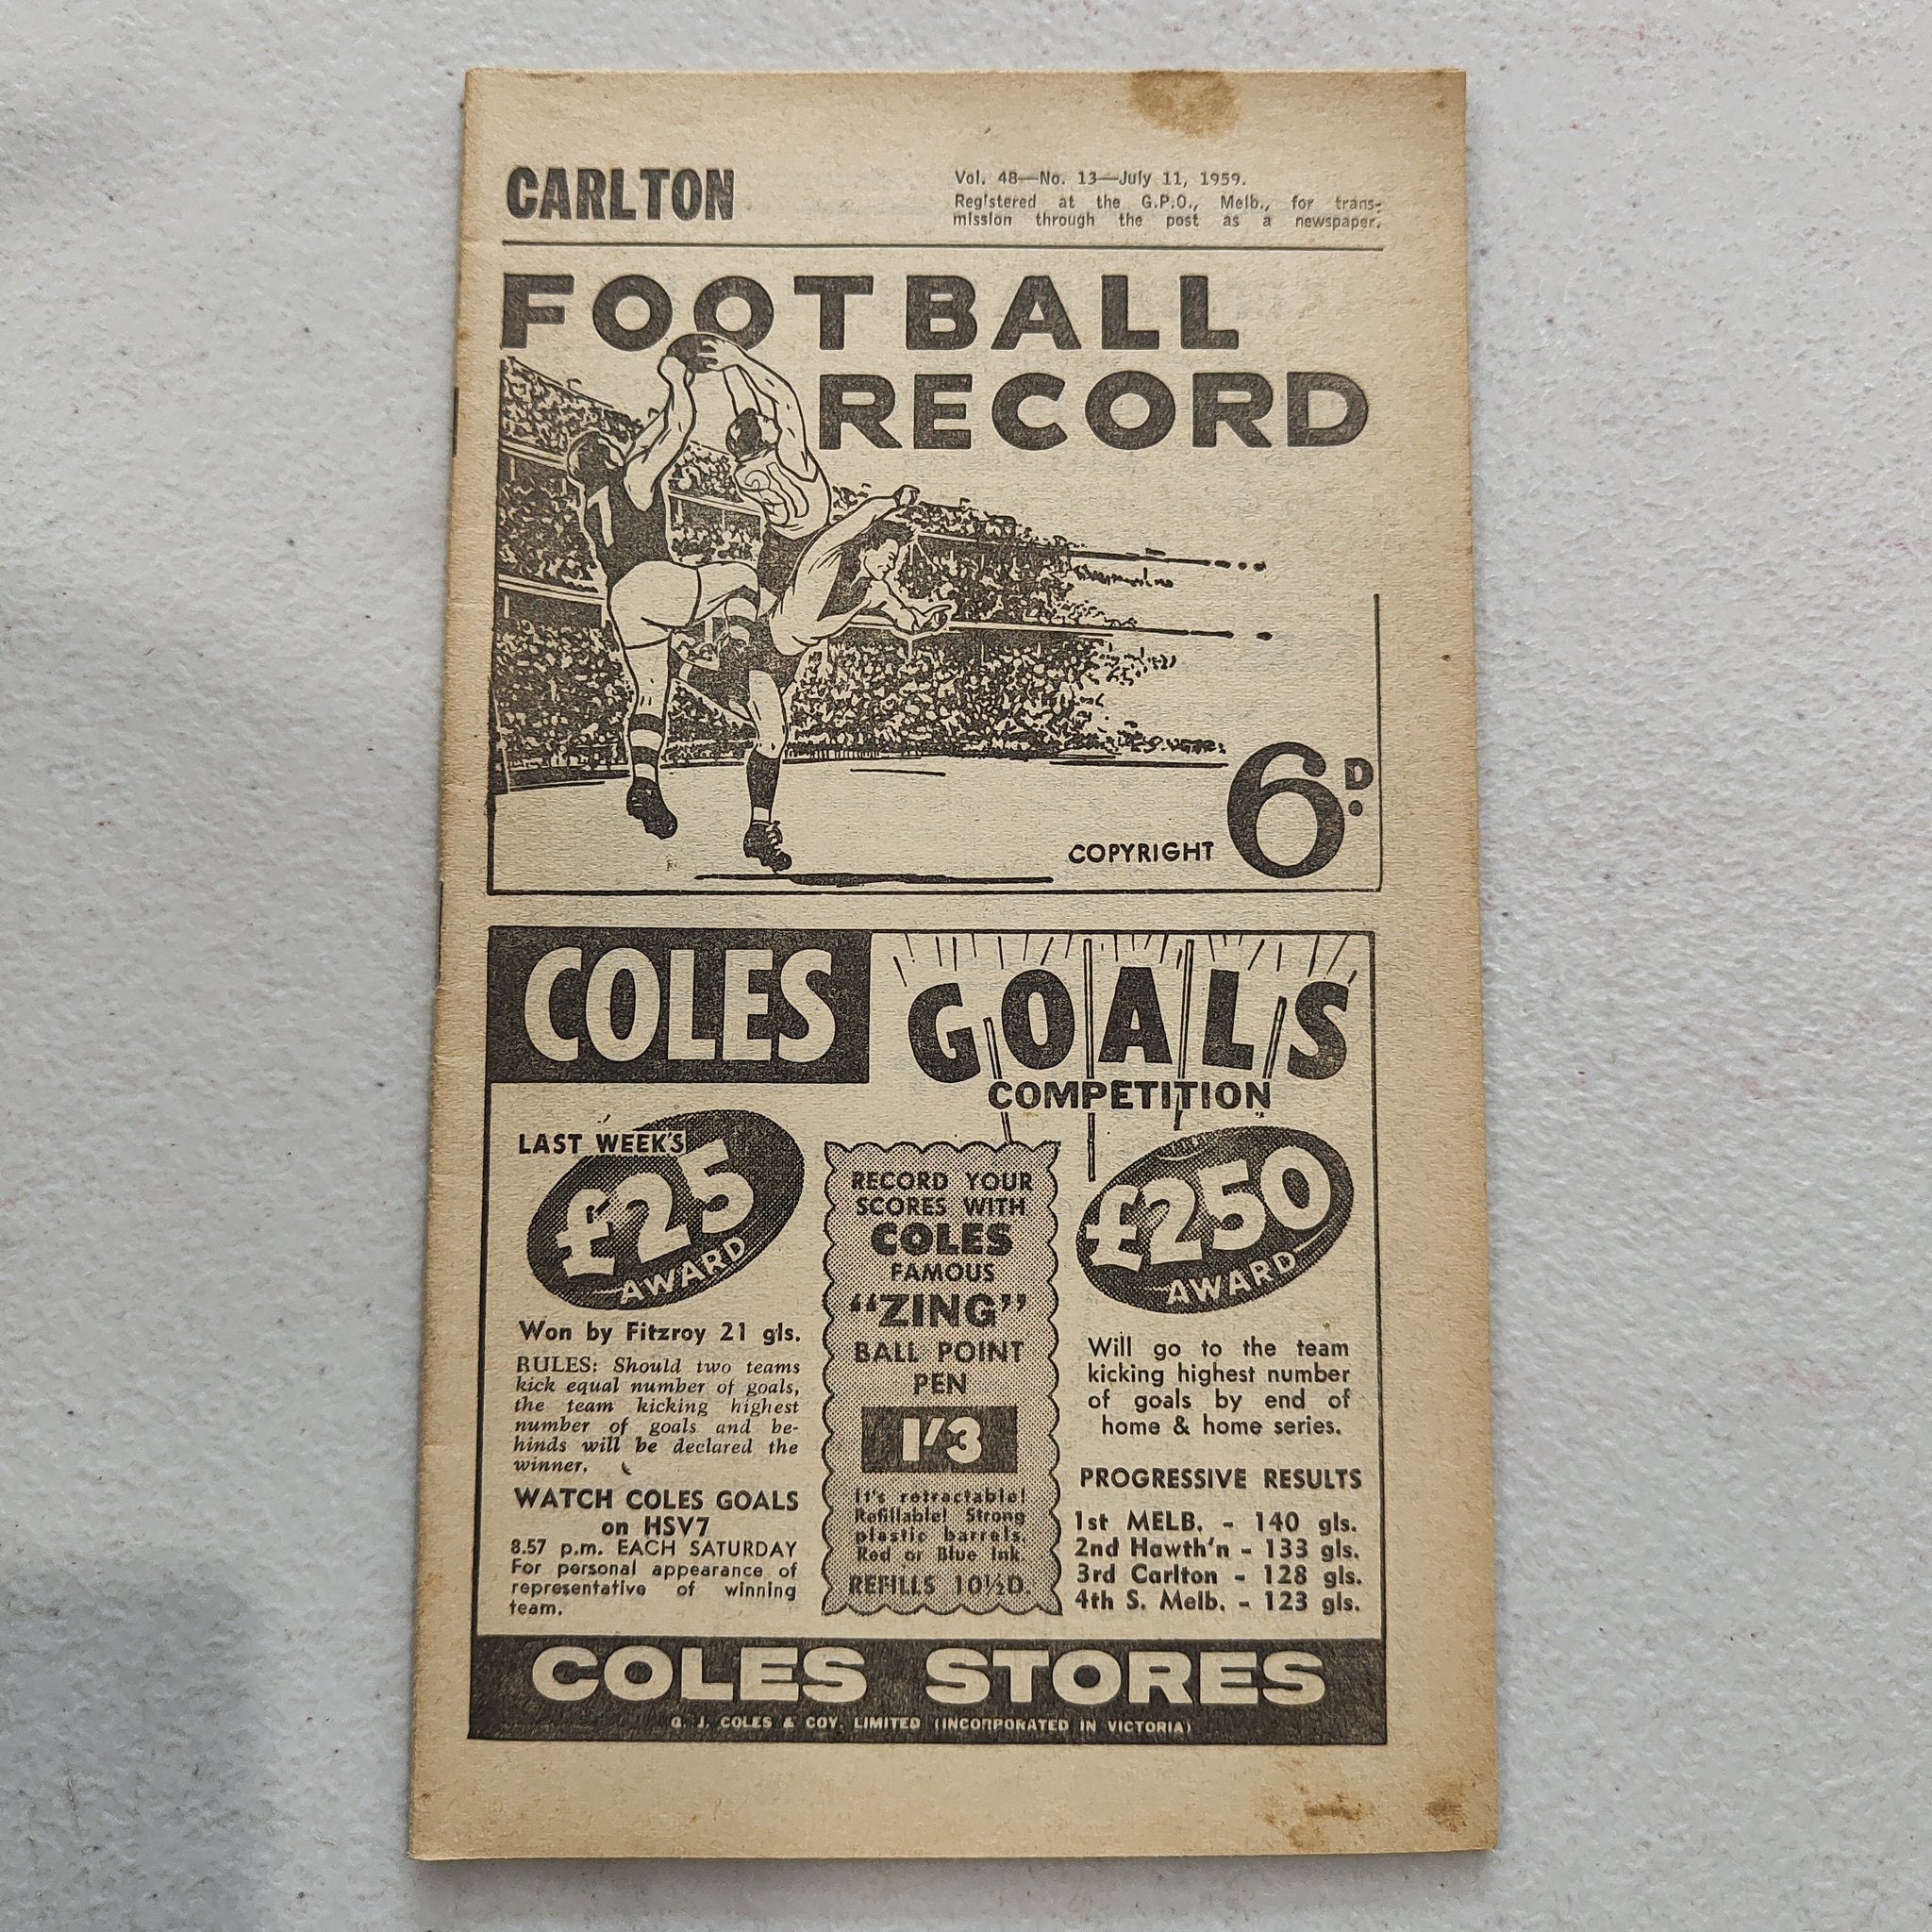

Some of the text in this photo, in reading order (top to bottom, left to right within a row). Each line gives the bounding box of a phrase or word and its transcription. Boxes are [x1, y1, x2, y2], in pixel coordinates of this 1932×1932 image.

[955, 170, 986, 185] Vol.
[1162, 171, 1188, 188] 11,
[1200, 172, 1246, 186] 1959.
[506, 167, 735, 221] CARLTON
[955, 193, 1036, 210] Registered
[1058, 195, 1075, 208] at
[1096, 194, 1121, 208] the
[1142, 194, 1198, 211] G.P.O.,
[1221, 194, 1270, 211] Melb.,
[1291, 195, 1313, 209] for
[953, 212, 1381, 230] mission through the post as a newspaper.
[499, 273, 1239, 352] FOOTBALL
[819, 371, 1369, 451] RECORD
[1068, 841, 1214, 863] COPYRIGHT
[525, 946, 836, 1062] COLES
[908, 966, 1350, 1083] GOALS
[988, 1079, 1271, 1109] COMPETITION
[519, 1133, 686, 1155] LAST WEEK'S
[851, 1171, 1034, 1191] RECORD YOUR
[555, 1139, 754, 1278] £25
[856, 1197, 1025, 1216] SCORES WITH
[1085, 1145, 1331, 1272] £250
[871, 1222, 1013, 1256] COLES
[619, 1237, 749, 1305] AWARD
[891, 1263, 994, 1282] FAMOUS
[1167, 1251, 1297, 1306] AWARD
[519, 1320, 801, 1345] Won by Fitzroy 21 gls.
[855, 1341, 1024, 1363] BALL POINT
[1088, 1331, 1349, 1360] Will go to the team
[517, 1357, 800, 1374] RULES: Should two teams
[1088, 1362, 1351, 1387] kicking highest number
[516, 1376, 800, 1396] kick equal number of goals,
[914, 1373, 966, 1394] PEN
[514, 1397, 799, 1416] the team kicking highest
[1088, 1388, 1351, 1413] of goals by end of
[514, 1416, 799, 1437] number of goals and be-
[1102, 1413, 1341, 1436] home & home series.
[513, 1437, 799, 1455] hinds will be declared the
[514, 1461, 588, 1474] winner.
[1080, 1467, 1362, 1490] PROGRESSIVE RESULTS
[514, 1487, 799, 1510] WATCH COLES GOALS
[900, 1488, 1025, 1504] retractable!
[601, 1515, 710, 1537] on HSV7
[855, 1507, 1024, 1525] Refillable! Strong
[1074, 1511, 1108, 1531] 1st
[1126, 1510, 1203, 1532] MELB.
[1255, 1511, 1299, 1532] 140
[1318, 1512, 1357, 1535] gls.
[856, 1526, 927, 1545] plastic
[510, 1539, 797, 1558] 8.57 p.m. EACH SATURDAY
[857, 1546, 891, 1562] Red
[904, 1549, 924, 1561] or
[937, 1546, 977, 1562] Blue
[1074, 1537, 1119, 1557] 2nd
[1131, 1537, 1229, 1557] Hawth'n
[1266, 1538, 1307, 1558] 133
[1321, 1538, 1359, 1562] gls.
[511, 1559, 799, 1581] For personal appearance of
[1076, 1563, 1115, 1584] 3rd
[1131, 1563, 1218, 1585] Carlton
[1264, 1563, 1307, 1585] 128
[1323, 1564, 1362, 1589] gls.
[511, 1581, 796, 1601] representative of winning
[849, 1574, 936, 1595] REFILLS
[509, 1601, 563, 1616] team.
[1074, 1590, 1114, 1610] 4th
[1126, 1590, 1145, 1610] S.
[1159, 1590, 1225, 1611] Melb.
[1264, 1591, 1307, 1611] 123
[1322, 1591, 1360, 1615] gls.
[531, 1644, 1325, 1706] COLES STORES
[720, 1716, 773, 1728] COLES
[783, 1716, 794, 1728] &
[806, 1716, 844, 1729] COY.
[854, 1716, 921, 1729] LIMITED
[935, 1717, 1069, 1731] (INCORPORATED
[1080, 1719, 1096, 1731] IN
[1107, 1720, 1191, 1733] VICTORIA)
